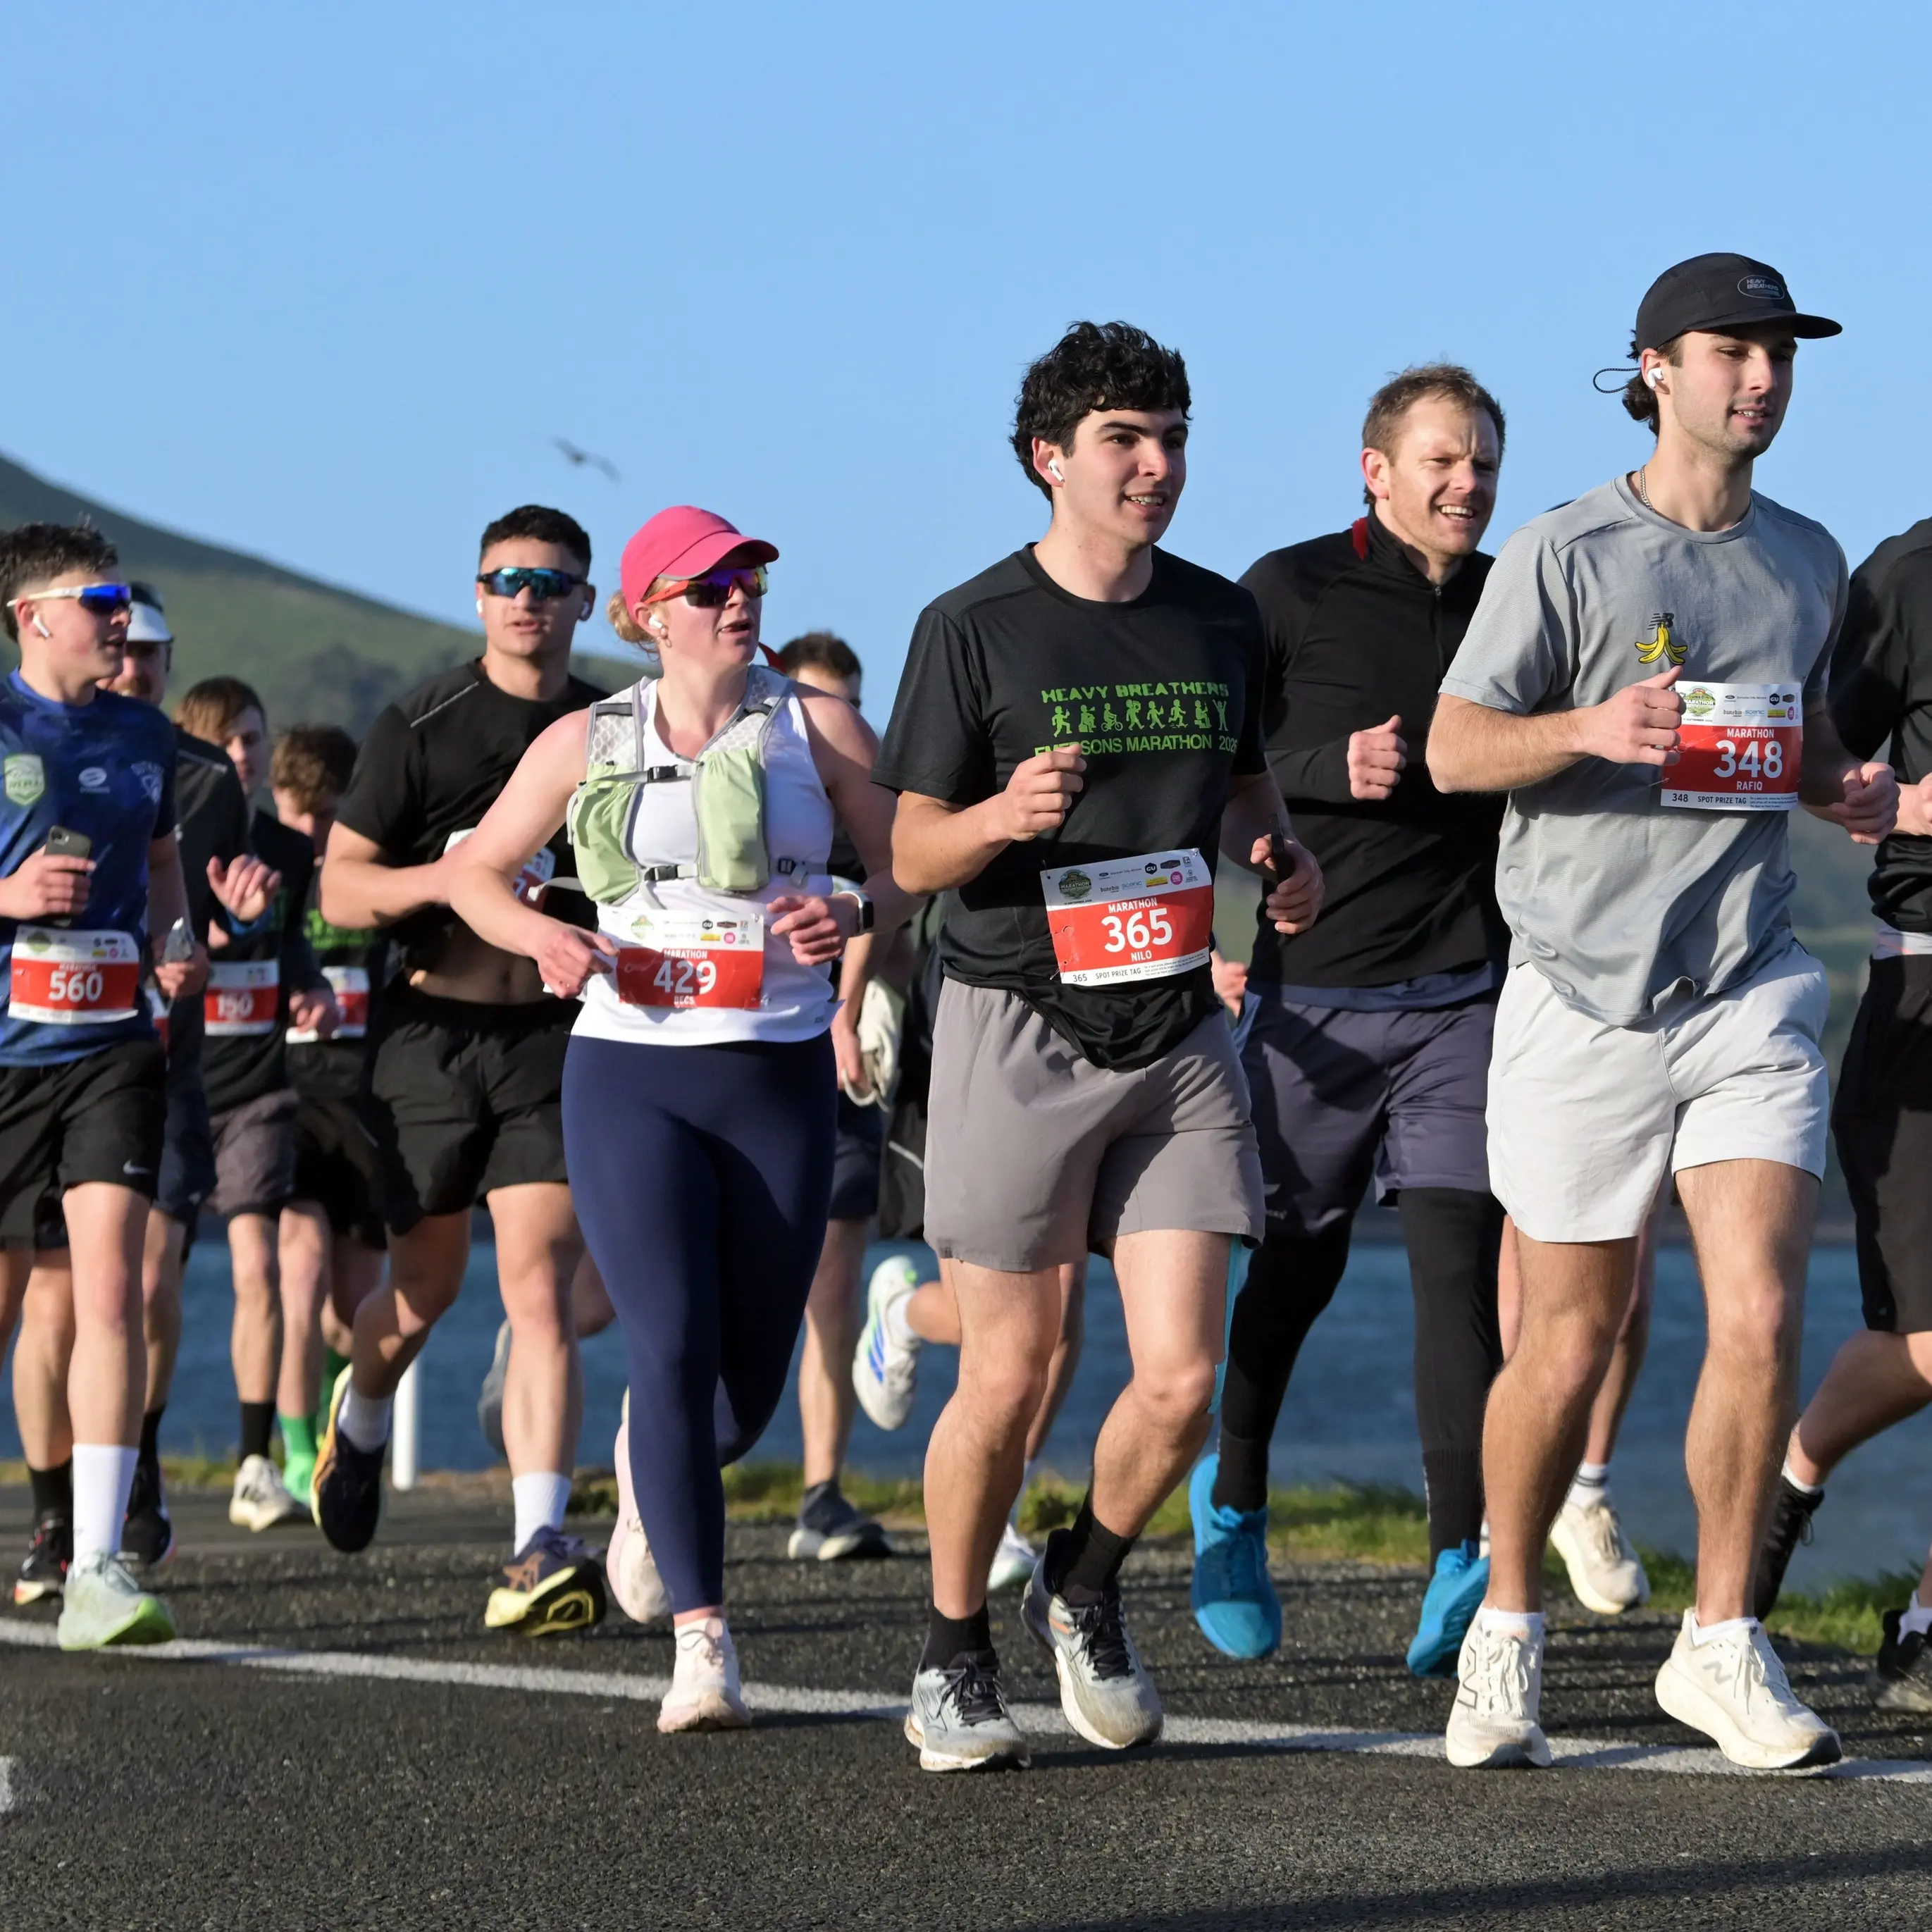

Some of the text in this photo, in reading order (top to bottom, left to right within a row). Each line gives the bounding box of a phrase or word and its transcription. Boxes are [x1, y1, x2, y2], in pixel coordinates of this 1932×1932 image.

[1041, 681, 1229, 703] HEAVY BREATHERS
[1727, 729, 1774, 738] MARATHON
[1127, 733, 1212, 752] MARATHON
[1713, 740, 1783, 779] 348
[1736, 781, 1763, 791] RAFIQ
[1672, 793, 1688, 803] 348
[1108, 897, 1158, 913] MARATHON
[1101, 908, 1172, 953] 365
[664, 950, 707, 959] MARATHON
[1131, 950, 1152, 962] NILO
[653, 960, 717, 995] 429
[1072, 973, 1088, 982] 365
[48, 970, 104, 1003] 560
